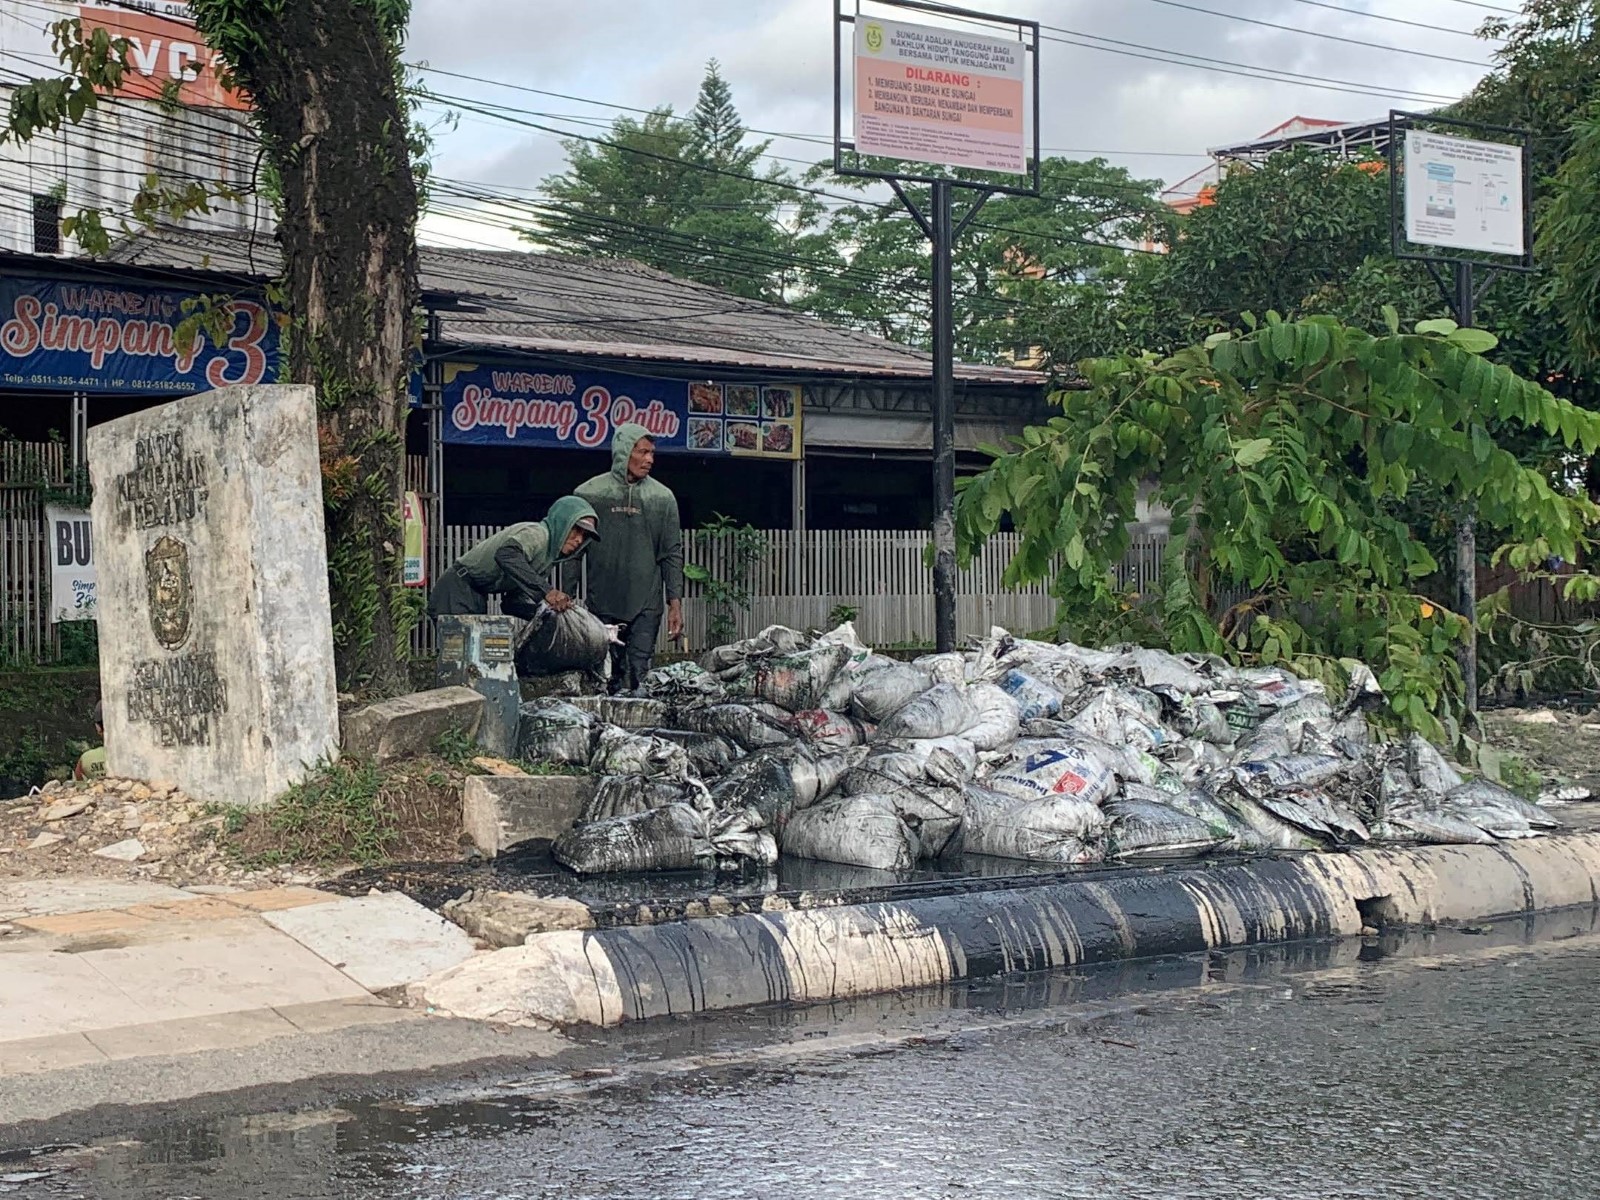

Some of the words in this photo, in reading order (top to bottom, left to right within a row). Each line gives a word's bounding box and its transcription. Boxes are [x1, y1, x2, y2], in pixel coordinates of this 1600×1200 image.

[890, 38, 925, 50] MAKHLUK
[951, 47, 989, 61] TANGGUNG
[991, 54, 1015, 65] JAWAB
[896, 30, 923, 41] SUNGAI
[925, 34, 952, 46] ADALAH
[954, 39, 992, 52] ANUGERAH
[993, 45, 1010, 56] BAGI
[899, 48, 933, 60] BERSAMA
[934, 54, 959, 65] UNTUK
[960, 58, 1007, 72] MENJAGANYA
[875, 77, 913, 92] MEMBUANG
[913, 83, 940, 96] SAMPAH
[941, 87, 951, 98] KE
[951, 89, 976, 102] SUNGAI
[906, 67, 970, 87] DILARANG
[912, 106, 941, 120] BANTARAN
[941, 110, 962, 123] SUNGAI
[967, 103, 978, 114] DAN
[61, 286, 177, 318] WAROENG
[206, 300, 269, 388] 3
[3, 373, 24, 384] Telp
[78, 377, 100, 387] 4471
[111, 378, 125, 388] HP
[492, 371, 576, 396] WAROENG
[452, 384, 578, 440] Simpang
[575, 386, 611, 447] 3
[56, 521, 93, 566] BU
[74, 591, 85, 609] 3
